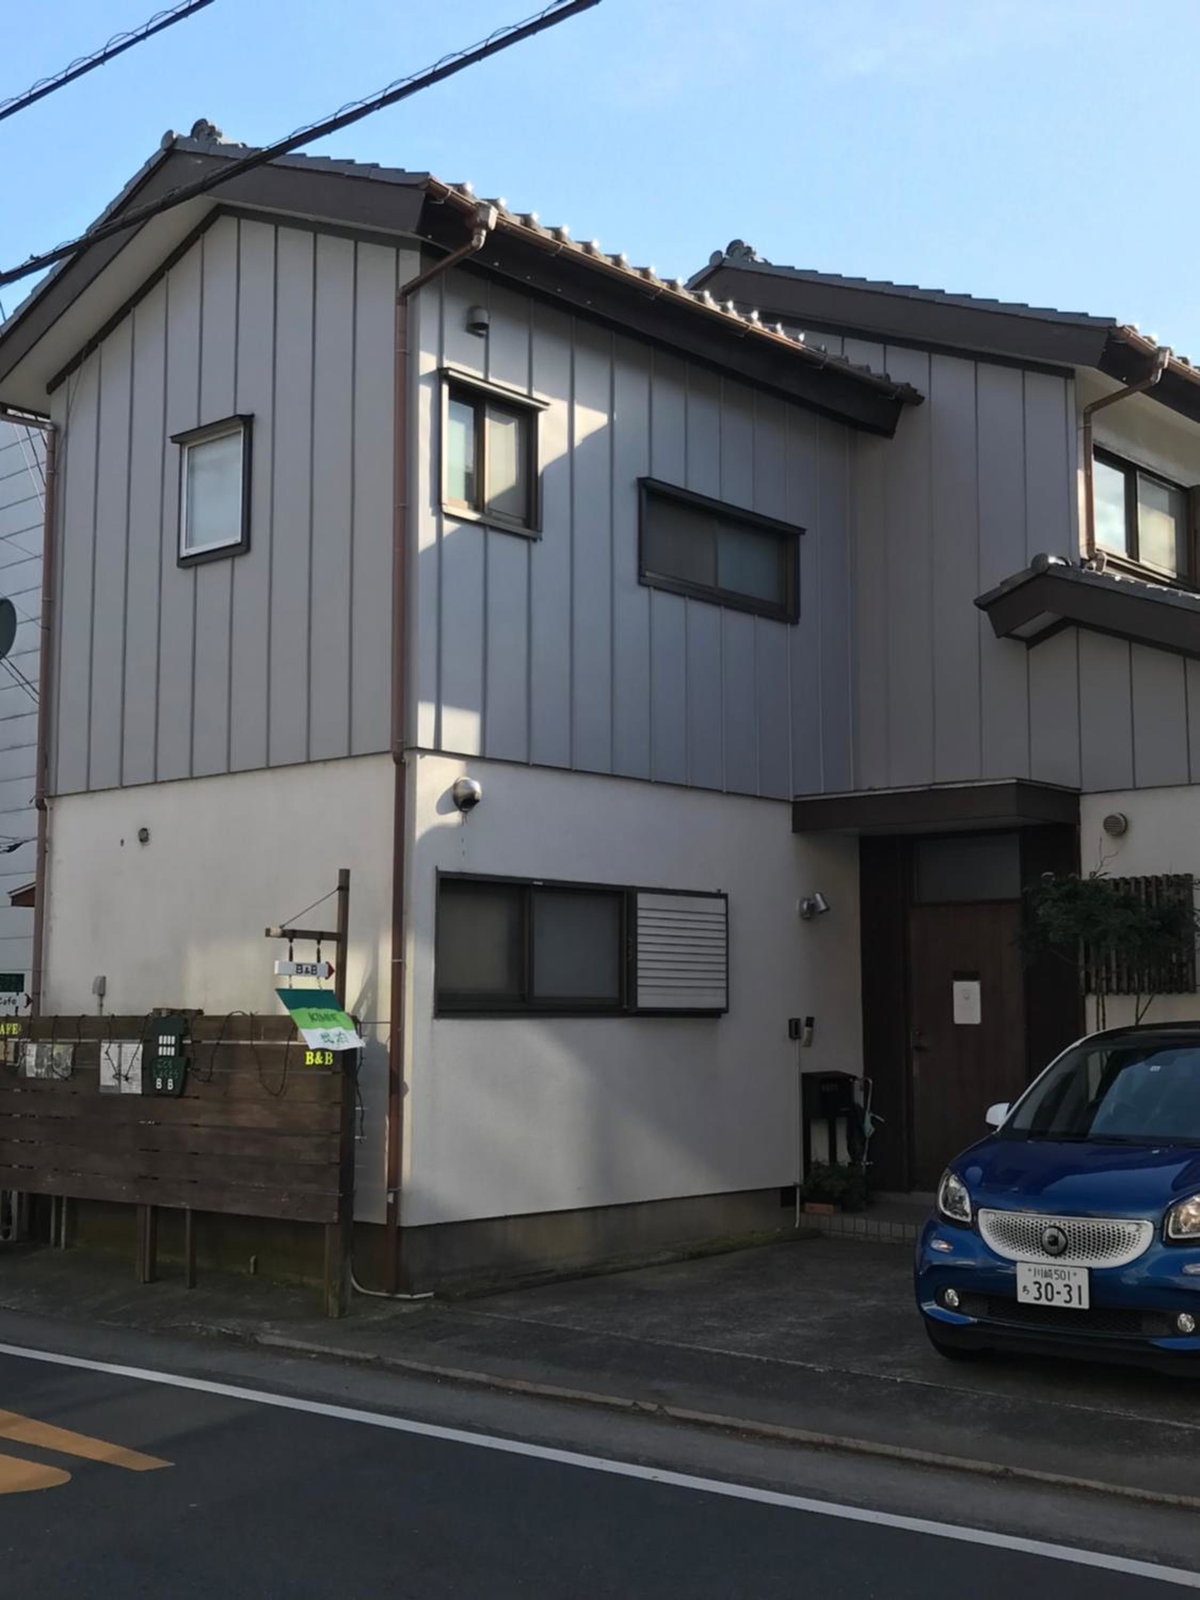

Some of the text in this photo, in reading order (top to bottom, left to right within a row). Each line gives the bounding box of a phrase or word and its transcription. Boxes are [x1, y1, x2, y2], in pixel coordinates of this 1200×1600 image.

[295, 963, 318, 975] B&B
[305, 1051, 333, 1065] B&B
[1033, 1281, 1082, 1306] 30-31
